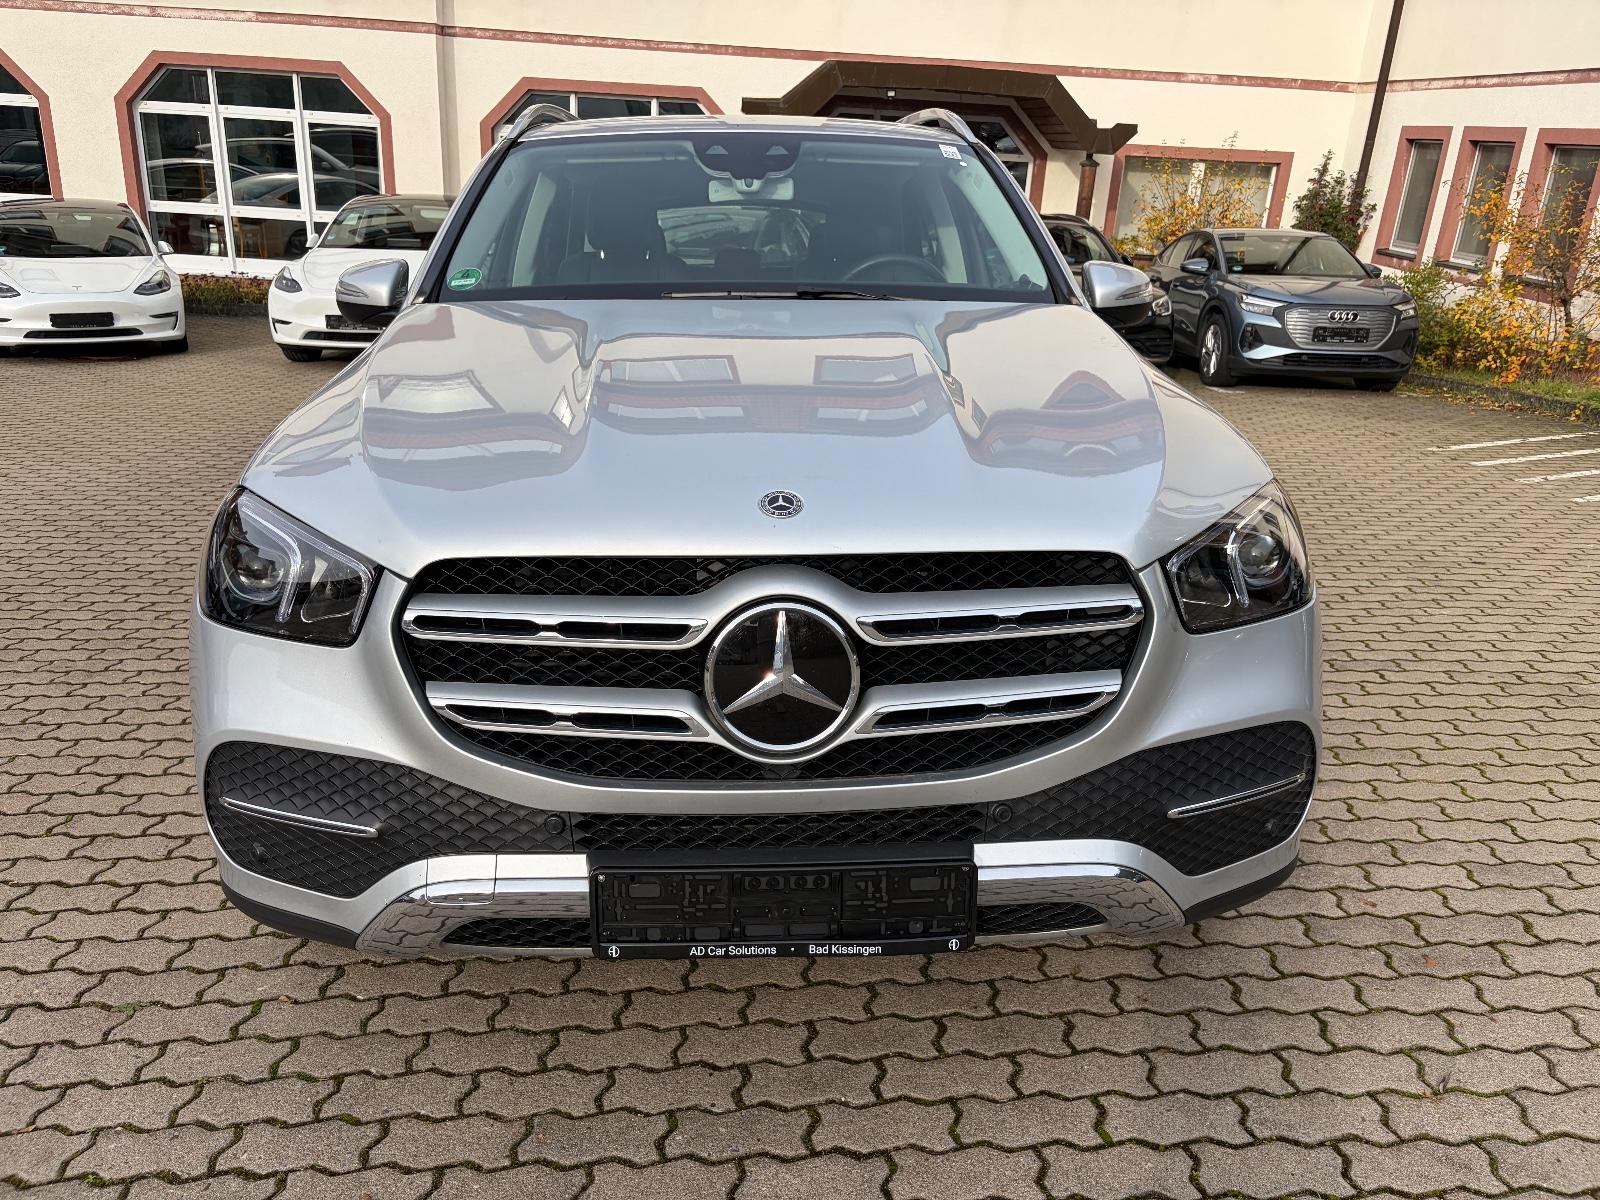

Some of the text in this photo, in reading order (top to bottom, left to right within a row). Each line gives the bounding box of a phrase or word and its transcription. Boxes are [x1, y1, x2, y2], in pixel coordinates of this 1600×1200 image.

[689, 944, 882, 956] AD Car Solutions Bad Kissingen
